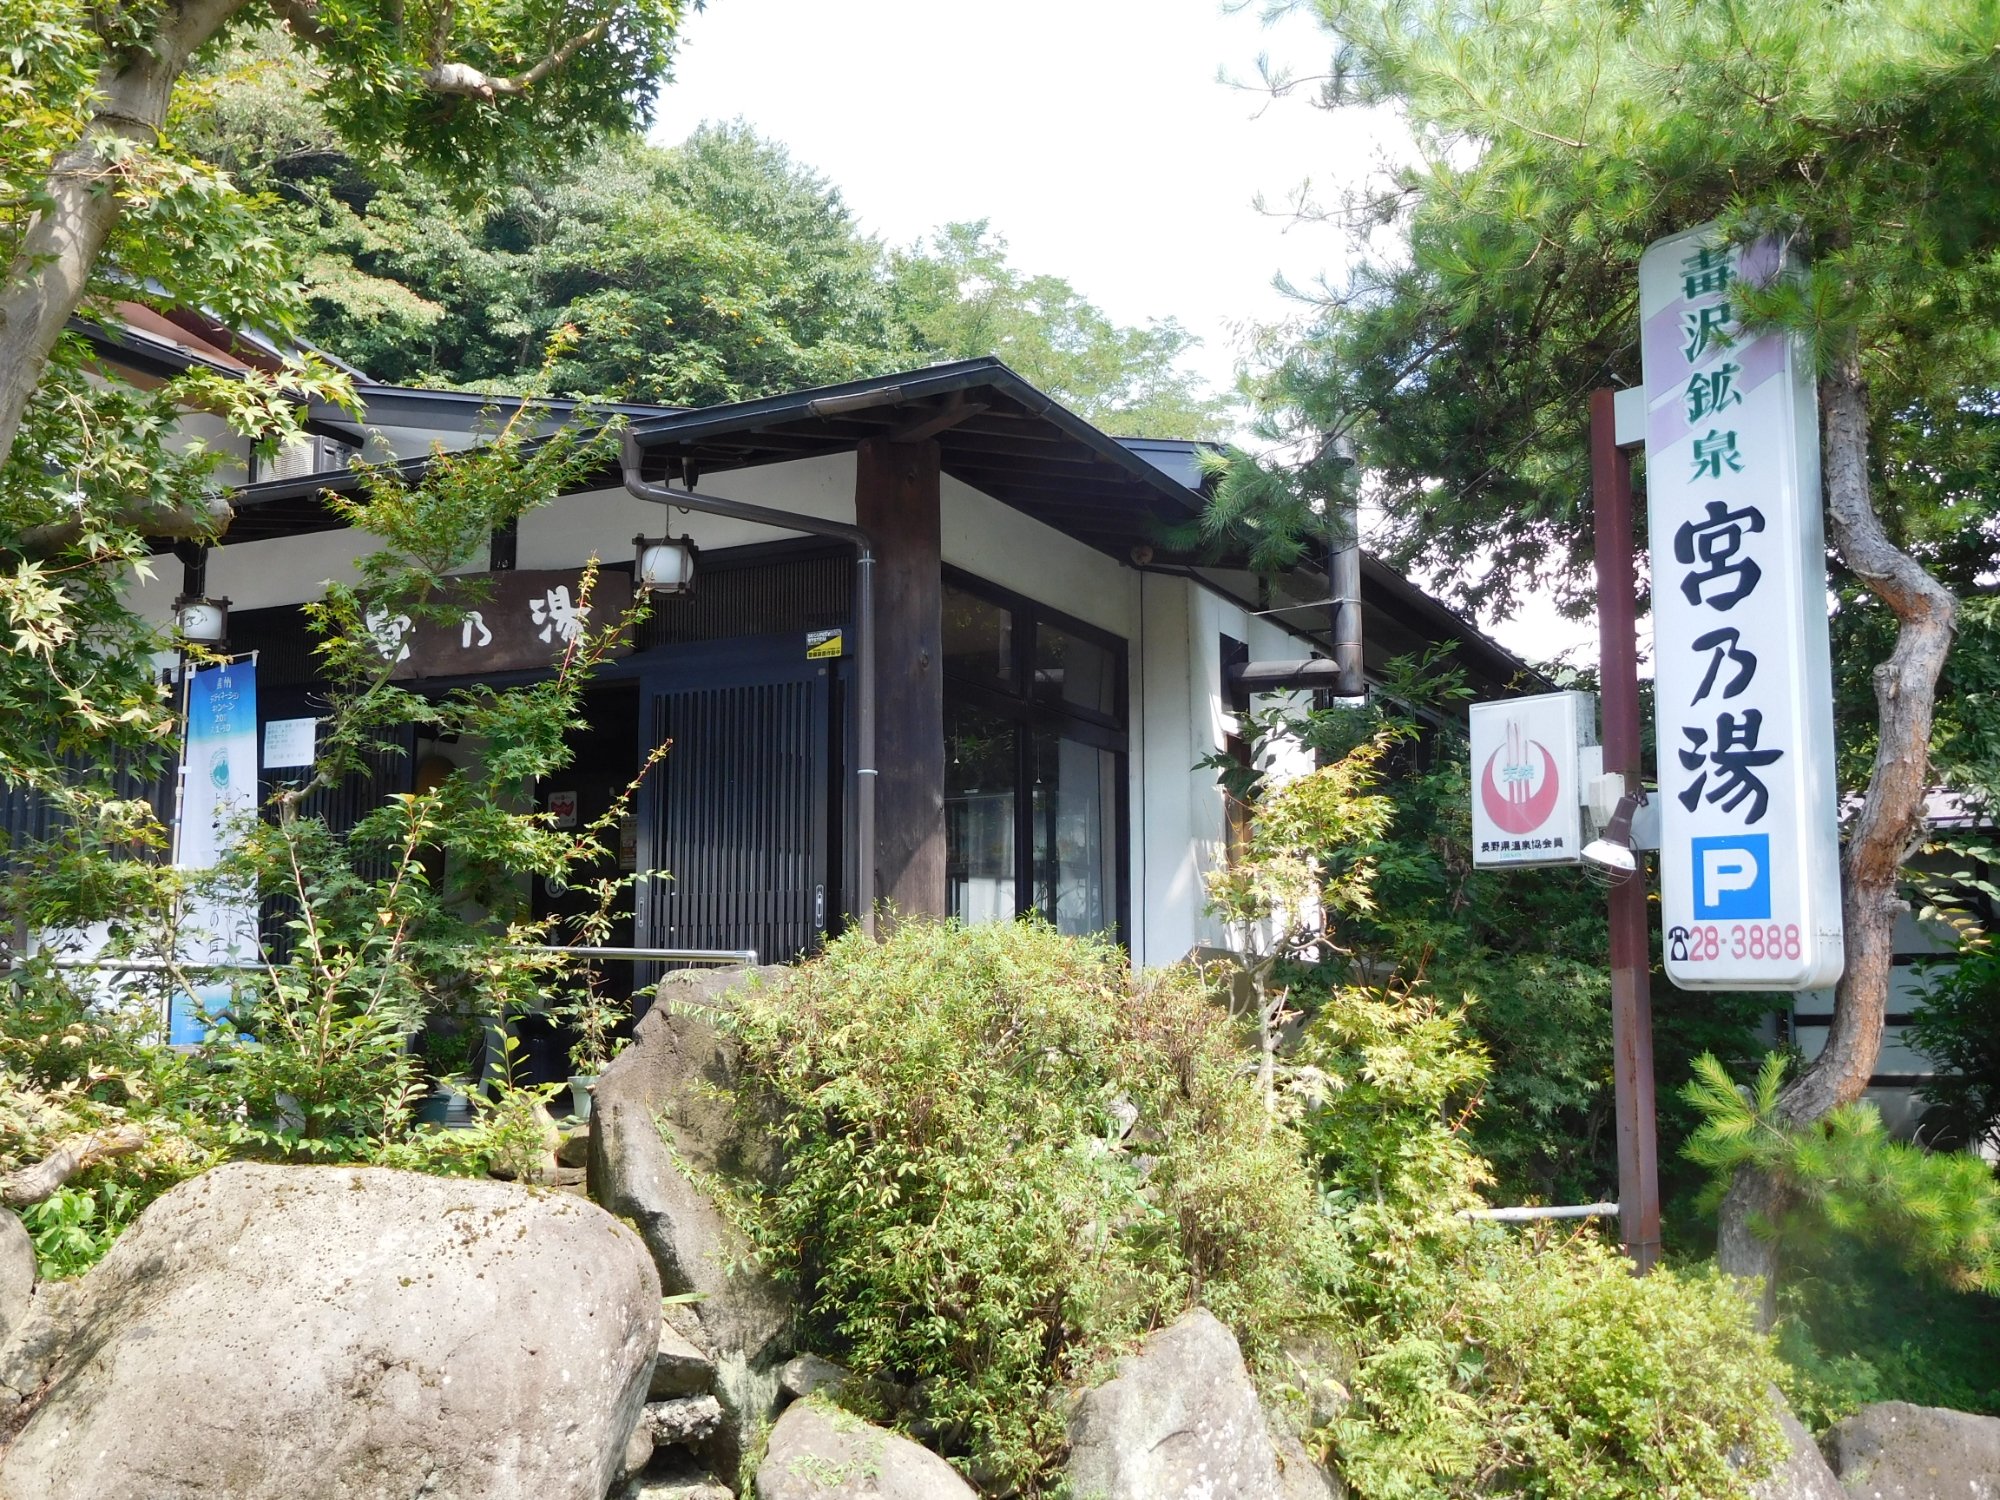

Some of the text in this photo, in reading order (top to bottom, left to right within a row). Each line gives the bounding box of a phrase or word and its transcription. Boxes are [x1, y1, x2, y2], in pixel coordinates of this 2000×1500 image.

[1674, 501, 1783, 824] 宮乃湯
[1481, 838, 1563, 852] 長野県温泉協会員
[1703, 848, 1757, 906] P
